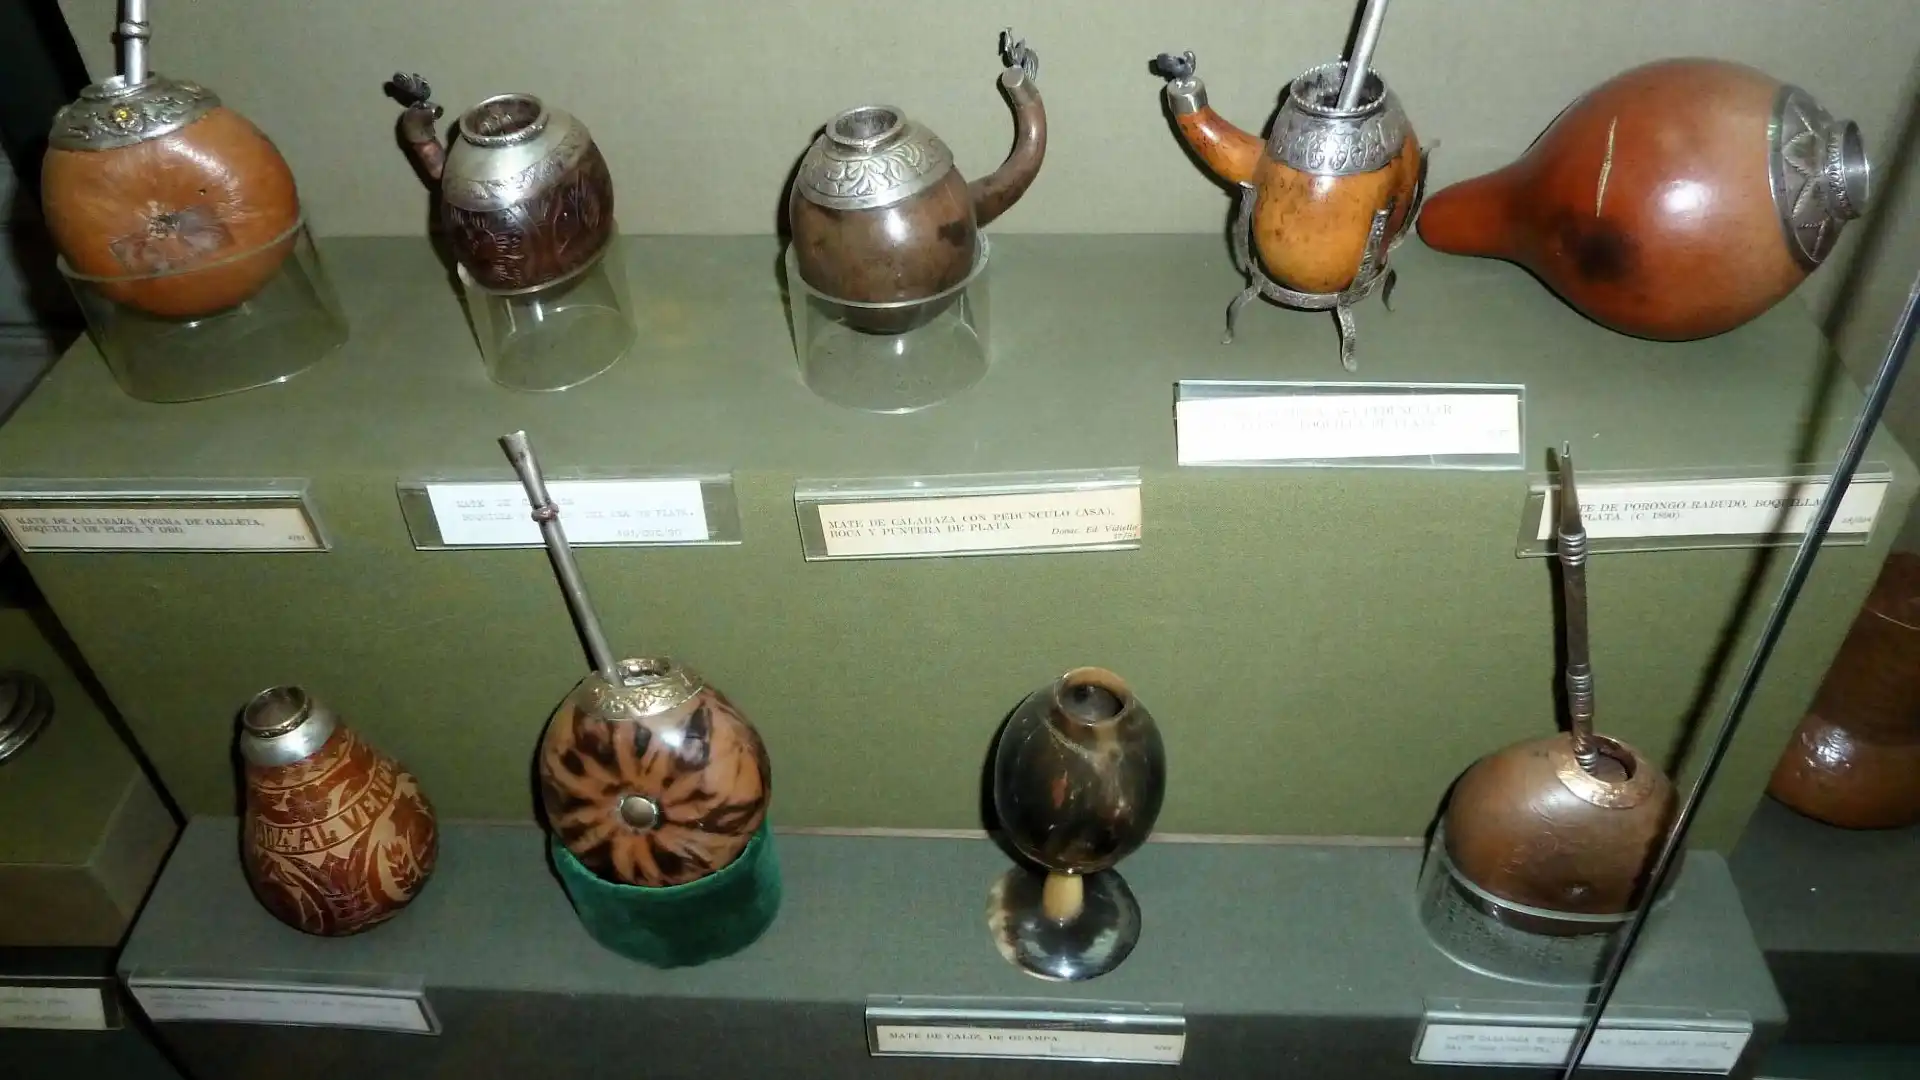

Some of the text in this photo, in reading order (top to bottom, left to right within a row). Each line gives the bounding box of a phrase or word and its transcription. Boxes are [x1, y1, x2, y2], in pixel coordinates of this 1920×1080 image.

[1600, 503, 1618, 512] DE
[1624, 501, 1686, 512] PORONGO
[185, 518, 202, 526] DE
[828, 520, 863, 529] MATE
[870, 518, 886, 527] DE
[891, 516, 956, 526] CALABAZA
[962, 513, 987, 522] CON
[830, 522, 1012, 538] BOCA Y PUNTERA DE PLATA
[889, 1032, 920, 1040] MATE
[926, 1032, 941, 1040] DE
